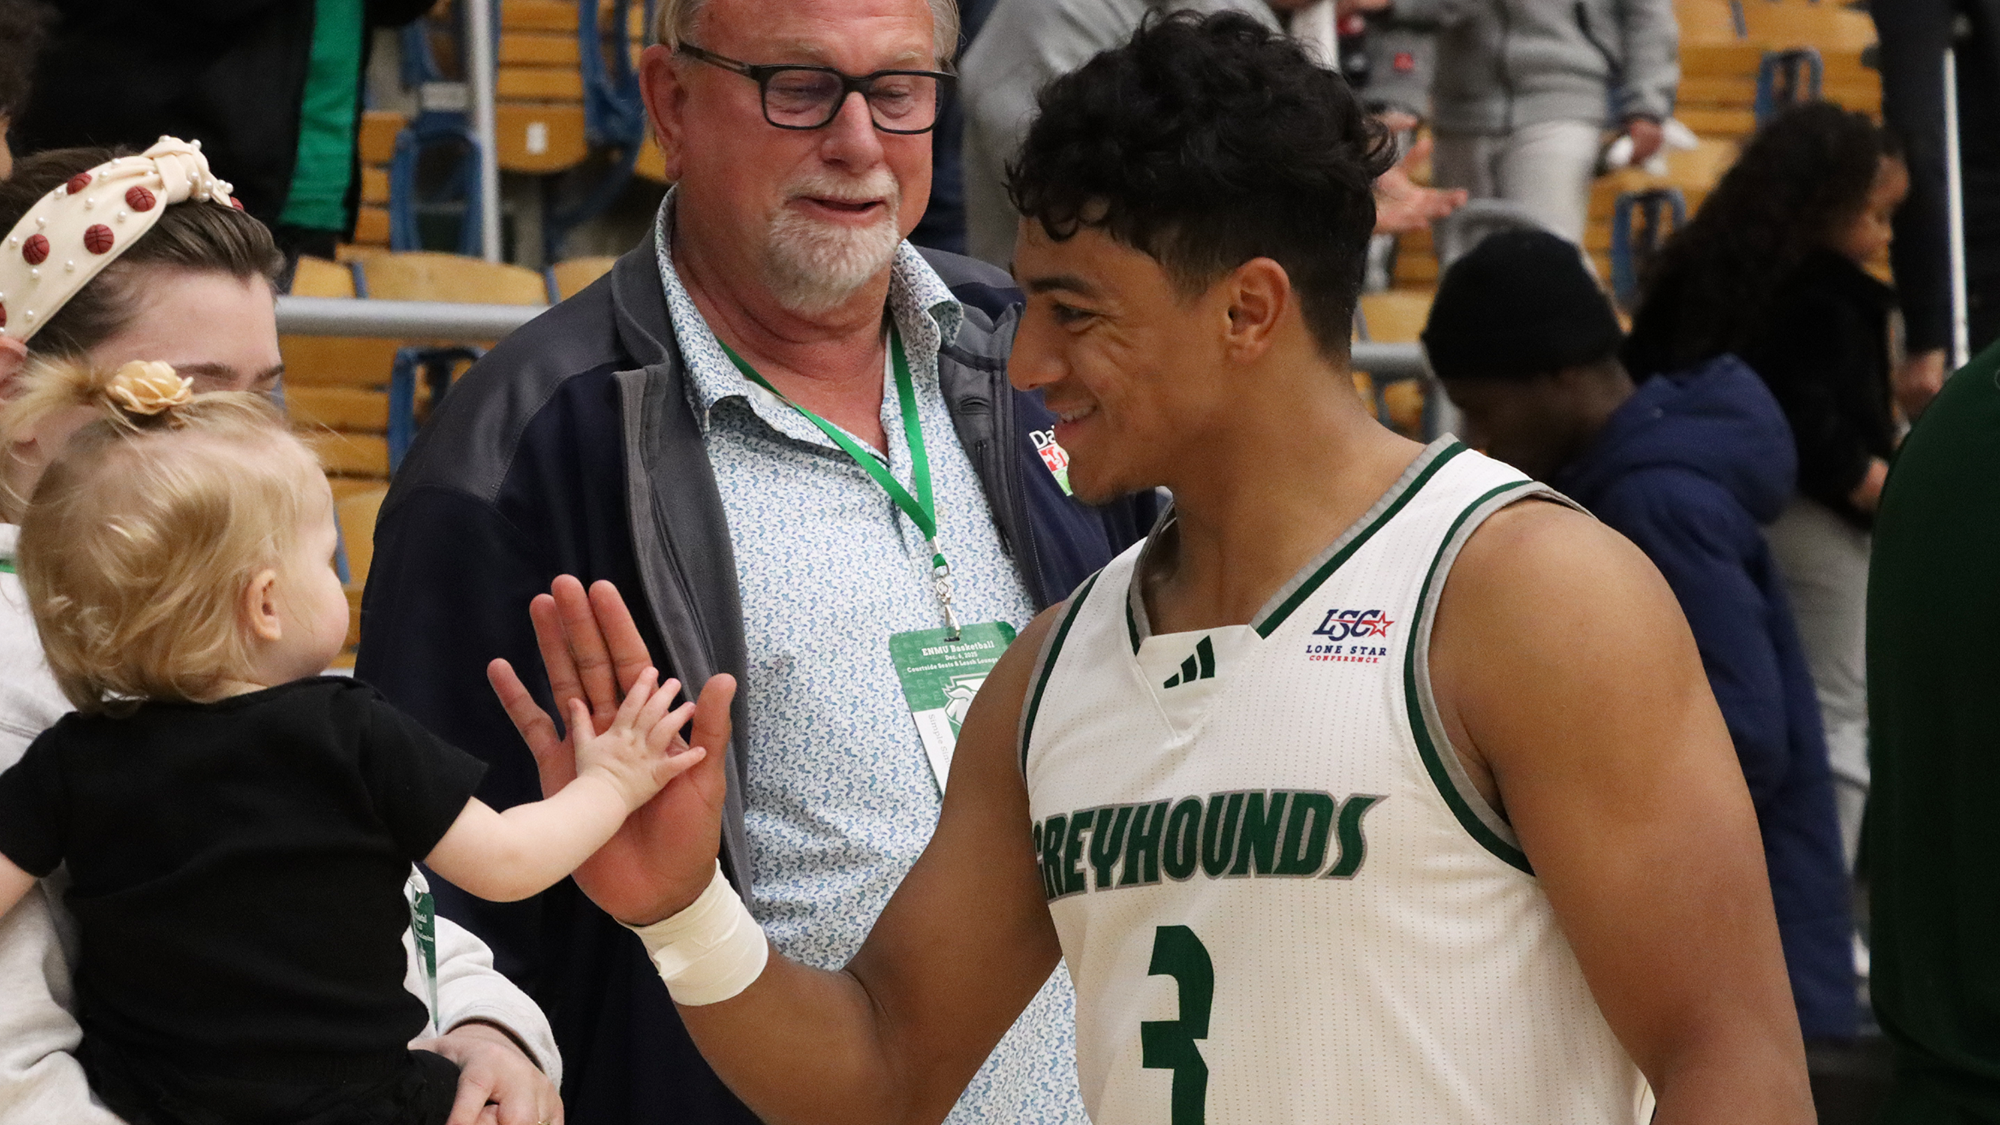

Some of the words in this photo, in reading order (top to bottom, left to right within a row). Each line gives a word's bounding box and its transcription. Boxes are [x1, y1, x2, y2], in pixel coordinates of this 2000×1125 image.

[1312, 609, 1381, 642] LSC
[922, 645, 949, 656] ENMU
[949, 640, 995, 653] Basketball
[1306, 645, 1343, 654] LONE
[1350, 645, 1387, 656] STAR
[965, 651, 978, 659] 2025
[1309, 655, 1380, 664] CONFERENCE
[907, 665, 937, 673] Courtside
[928, 714, 943, 744] Simple
[1141, 924, 1215, 1125] 3
